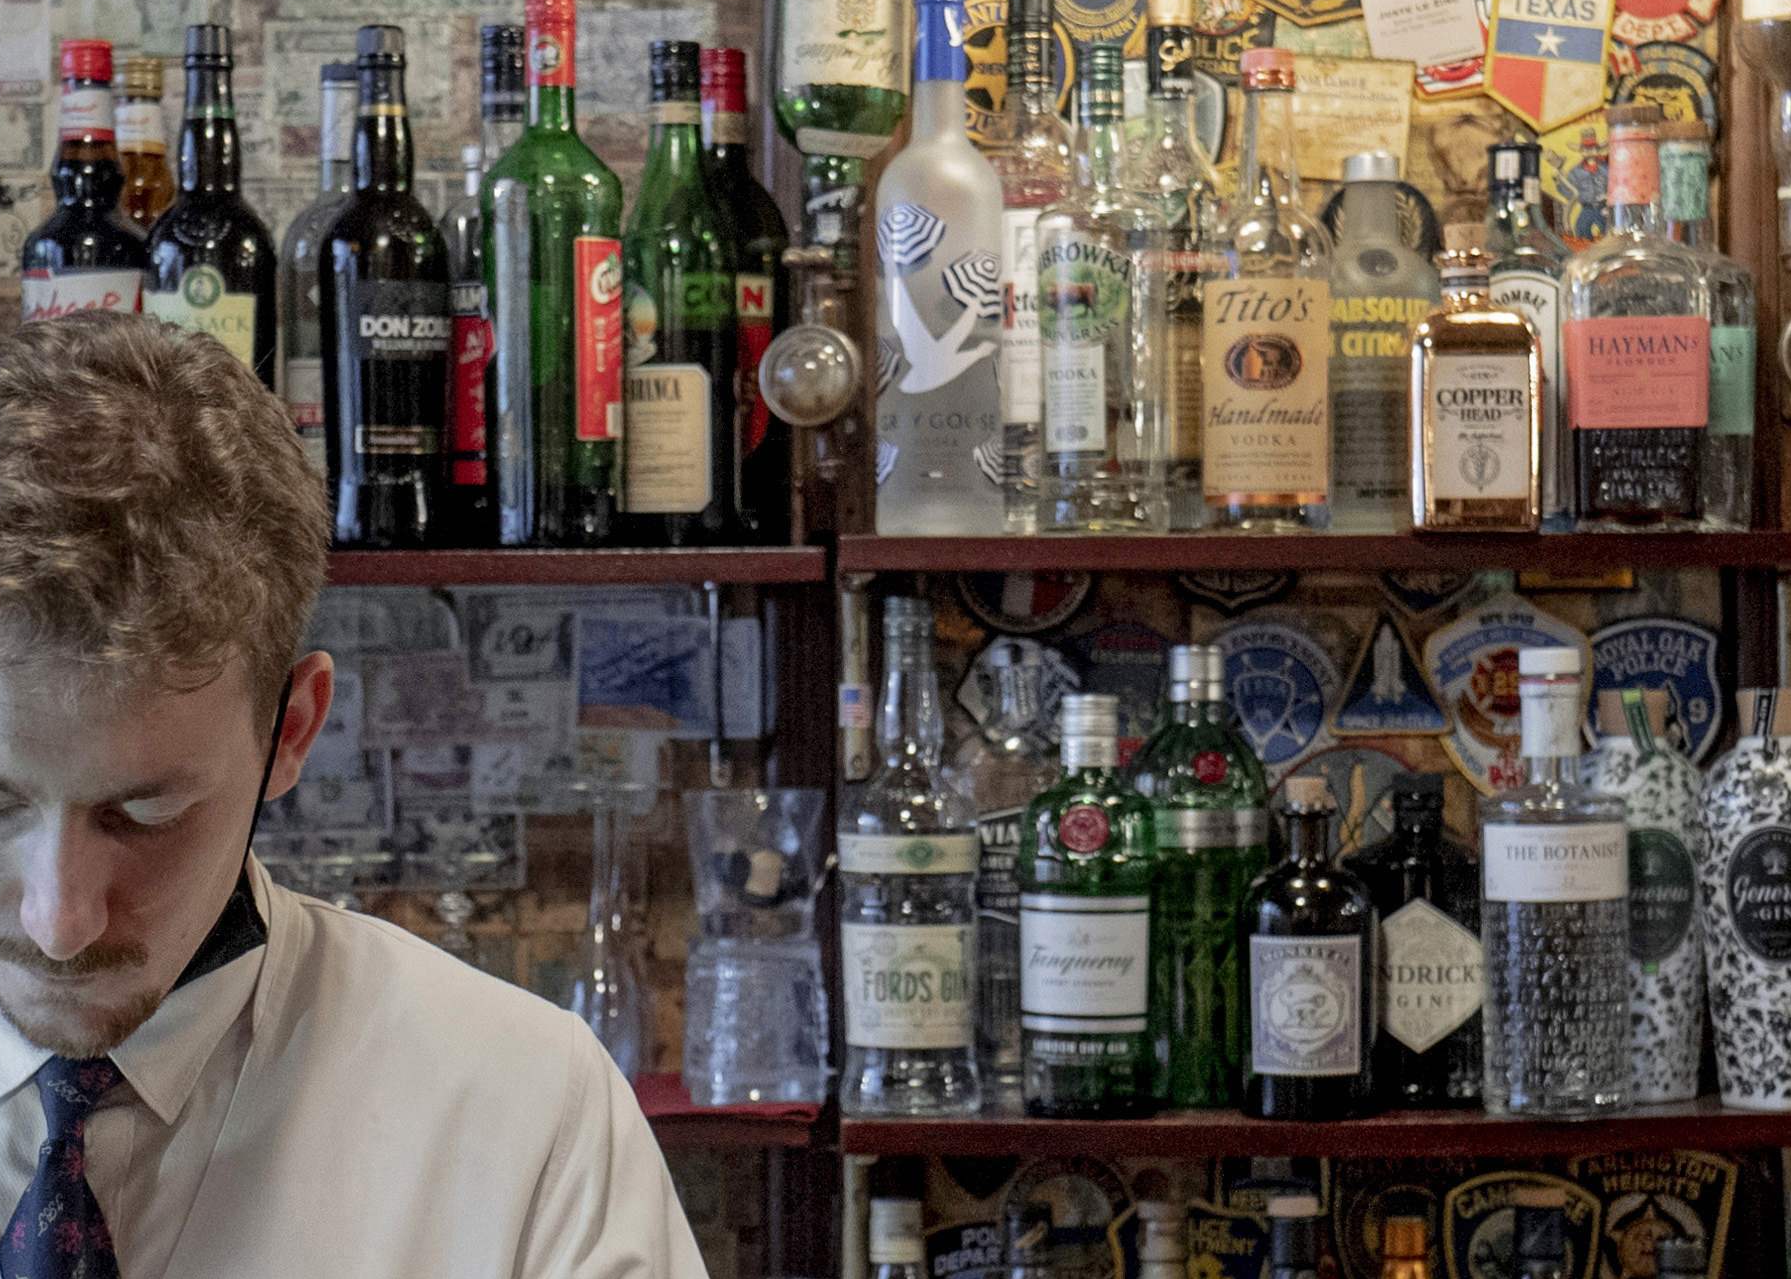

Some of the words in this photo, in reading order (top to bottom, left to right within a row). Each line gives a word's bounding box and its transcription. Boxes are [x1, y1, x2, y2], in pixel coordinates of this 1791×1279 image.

[1216, 288, 1314, 323] Tito's
[360, 315, 408, 338] DON
[1436, 389, 1524, 408] COPPER
[1210, 397, 1323, 427] Handmade
[1460, 408, 1503, 422] HEAD
[1230, 434, 1297, 447] VODKA
[1594, 632, 1653, 667] ROYAL
[1659, 632, 1702, 662] OAK
[1610, 653, 1688, 676] POLICE
[1506, 845, 1538, 861] THE
[1541, 842, 1621, 861] BOTANIST
[1026, 942, 1135, 976] Tanqueray
[862, 969, 932, 1003] FORDS
[1603, 1172, 1702, 1200] HEIGHTS
